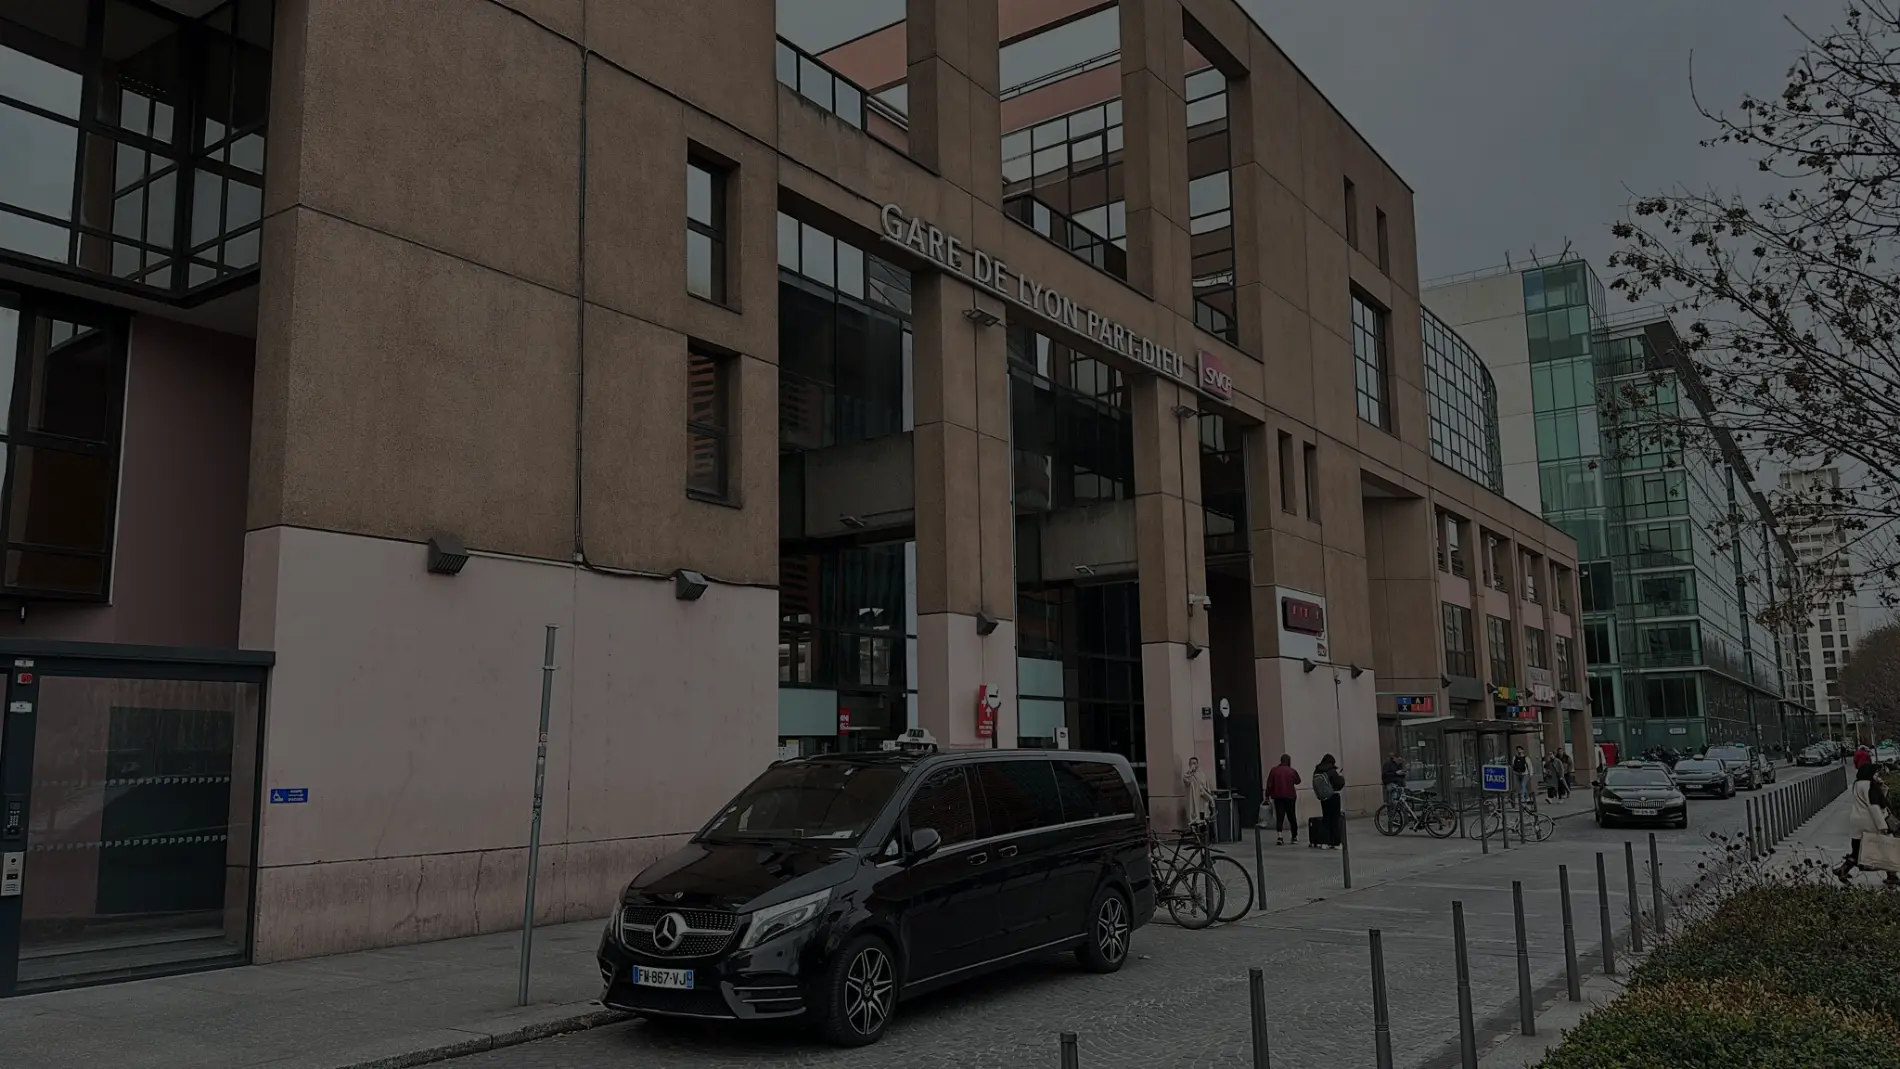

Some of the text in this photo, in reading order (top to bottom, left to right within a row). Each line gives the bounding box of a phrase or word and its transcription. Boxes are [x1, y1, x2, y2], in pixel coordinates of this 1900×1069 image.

[881, 204, 962, 271] GARE
[974, 250, 1007, 293] DE
[1019, 274, 1078, 328] LYON
[1204, 367, 1232, 391] SNCF
[1485, 774, 1506, 783] TAXIS
[639, 969, 686, 985] FW-867-VJ
